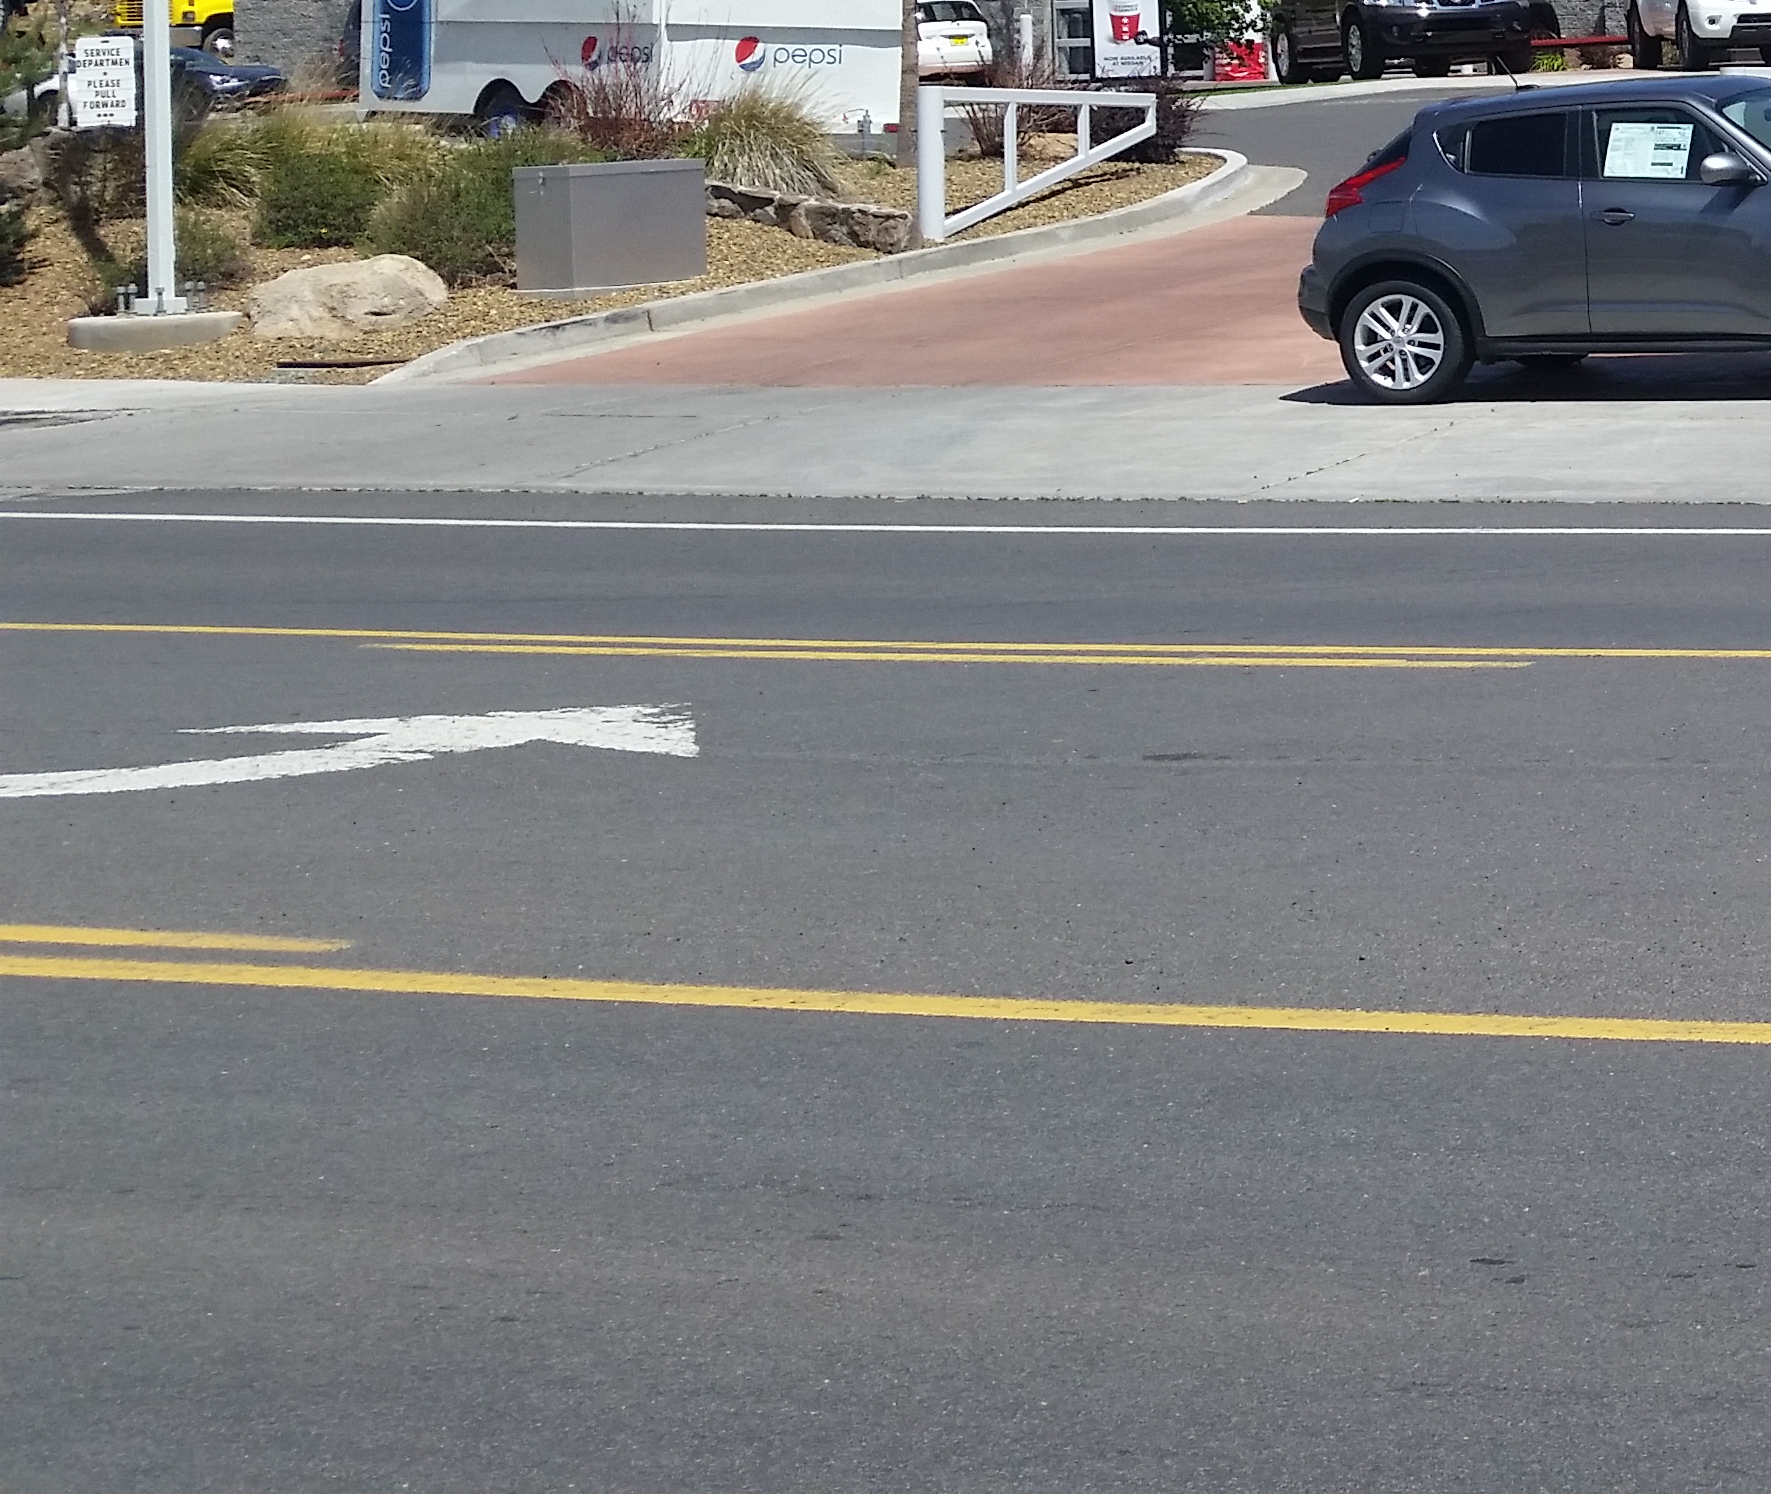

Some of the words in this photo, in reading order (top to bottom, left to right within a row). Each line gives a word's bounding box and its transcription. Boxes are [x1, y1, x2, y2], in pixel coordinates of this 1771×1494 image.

[84, 48, 121, 57] SERVICE
[378, 14, 393, 88] pepsi
[773, 44, 842, 68] pepsi
[87, 79, 121, 88] PLEASE
[95, 90, 116, 98] PULL
[83, 100, 126, 109] FORWARD
